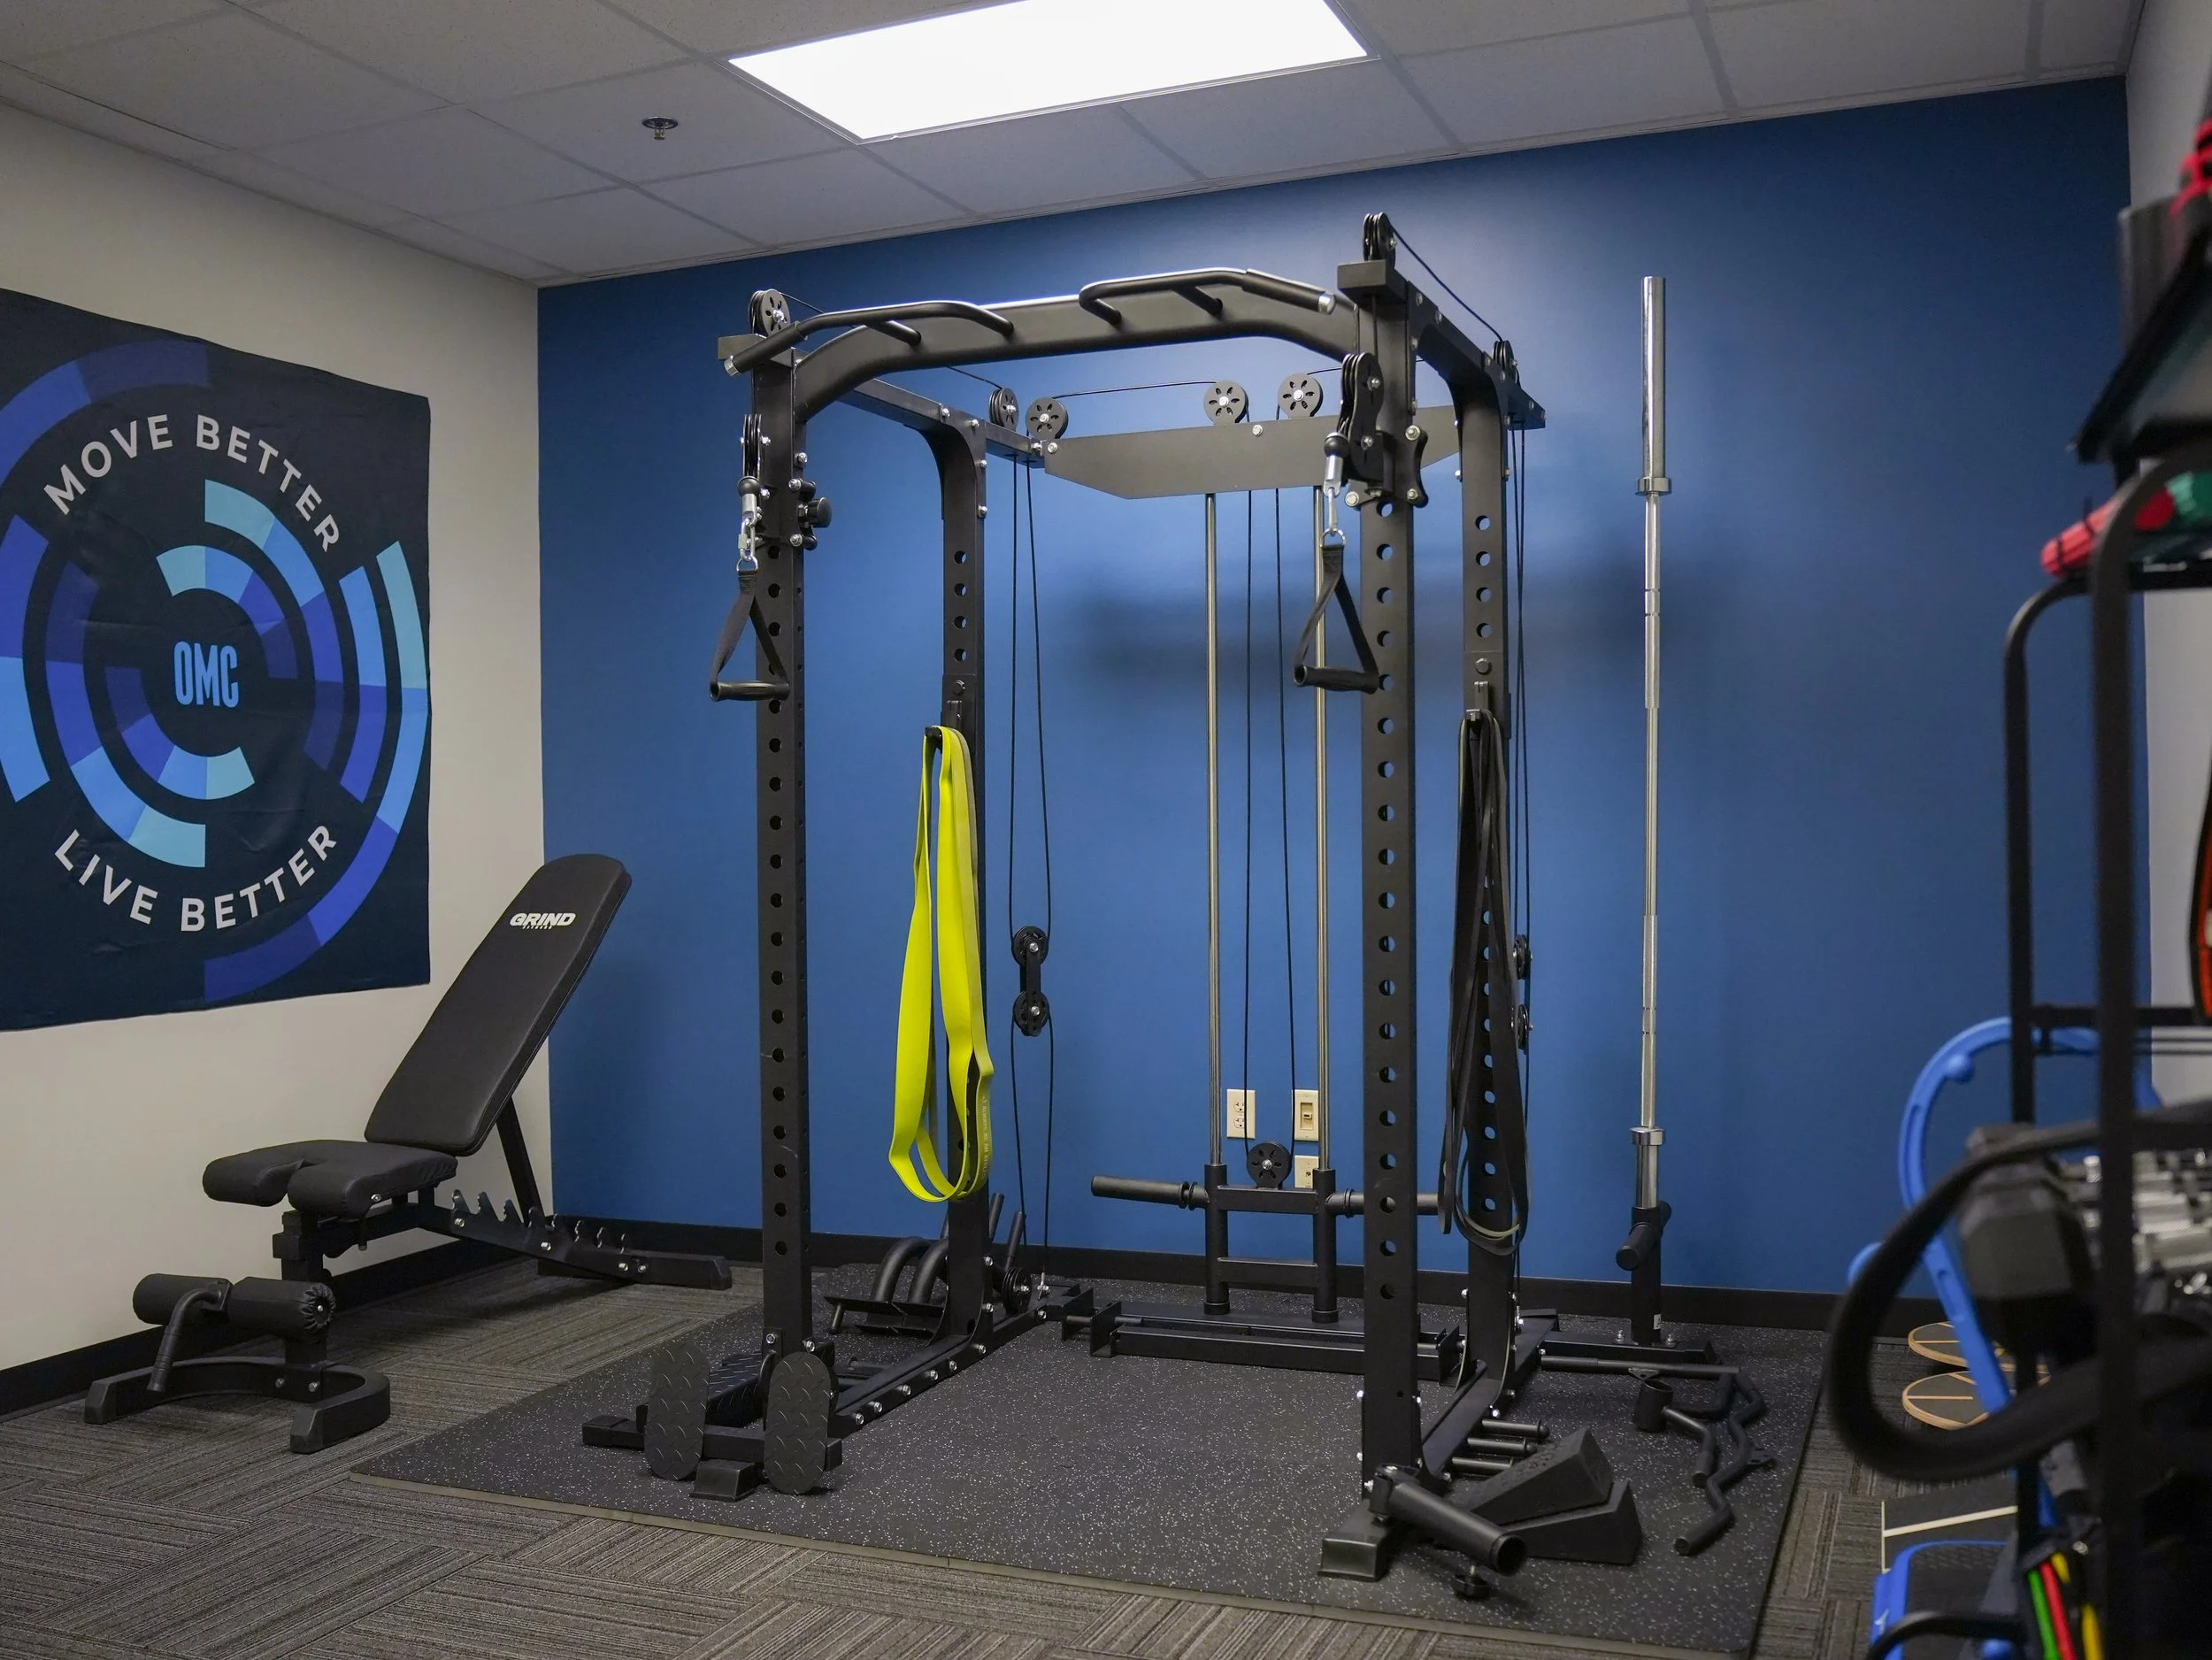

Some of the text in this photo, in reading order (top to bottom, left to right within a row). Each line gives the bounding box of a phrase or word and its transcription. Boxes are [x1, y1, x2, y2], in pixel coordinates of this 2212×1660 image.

[43, 413, 341, 552] MOVE BETTER
[173, 641, 239, 708] OMC
[54, 825, 338, 932] LIVE BETTER
[509, 912, 577, 926] GRIND
